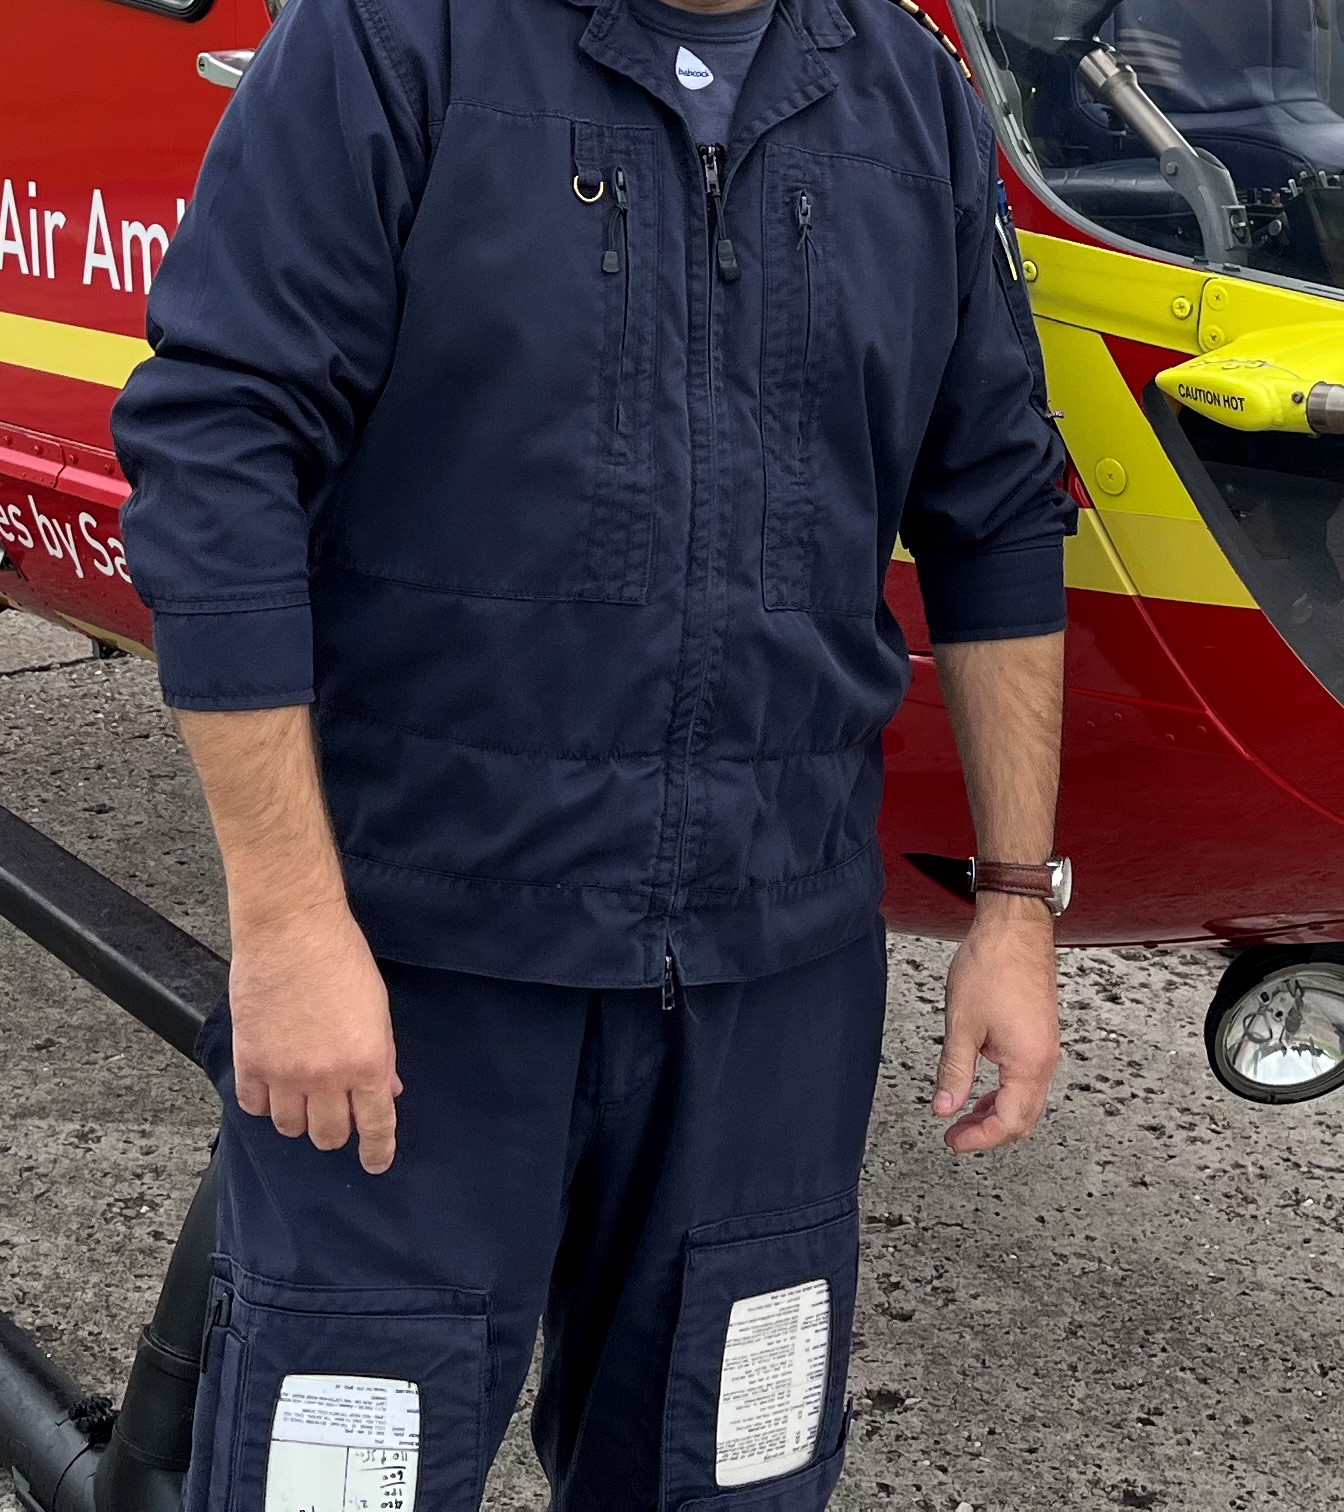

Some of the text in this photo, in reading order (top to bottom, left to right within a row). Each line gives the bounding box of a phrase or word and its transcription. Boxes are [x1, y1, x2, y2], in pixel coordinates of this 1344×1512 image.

[82, 188, 186, 295] Am
[1178, 383, 1245, 412] CAUTION HOT
[27, 494, 84, 579] by
[78, 511, 133, 585] Sa
